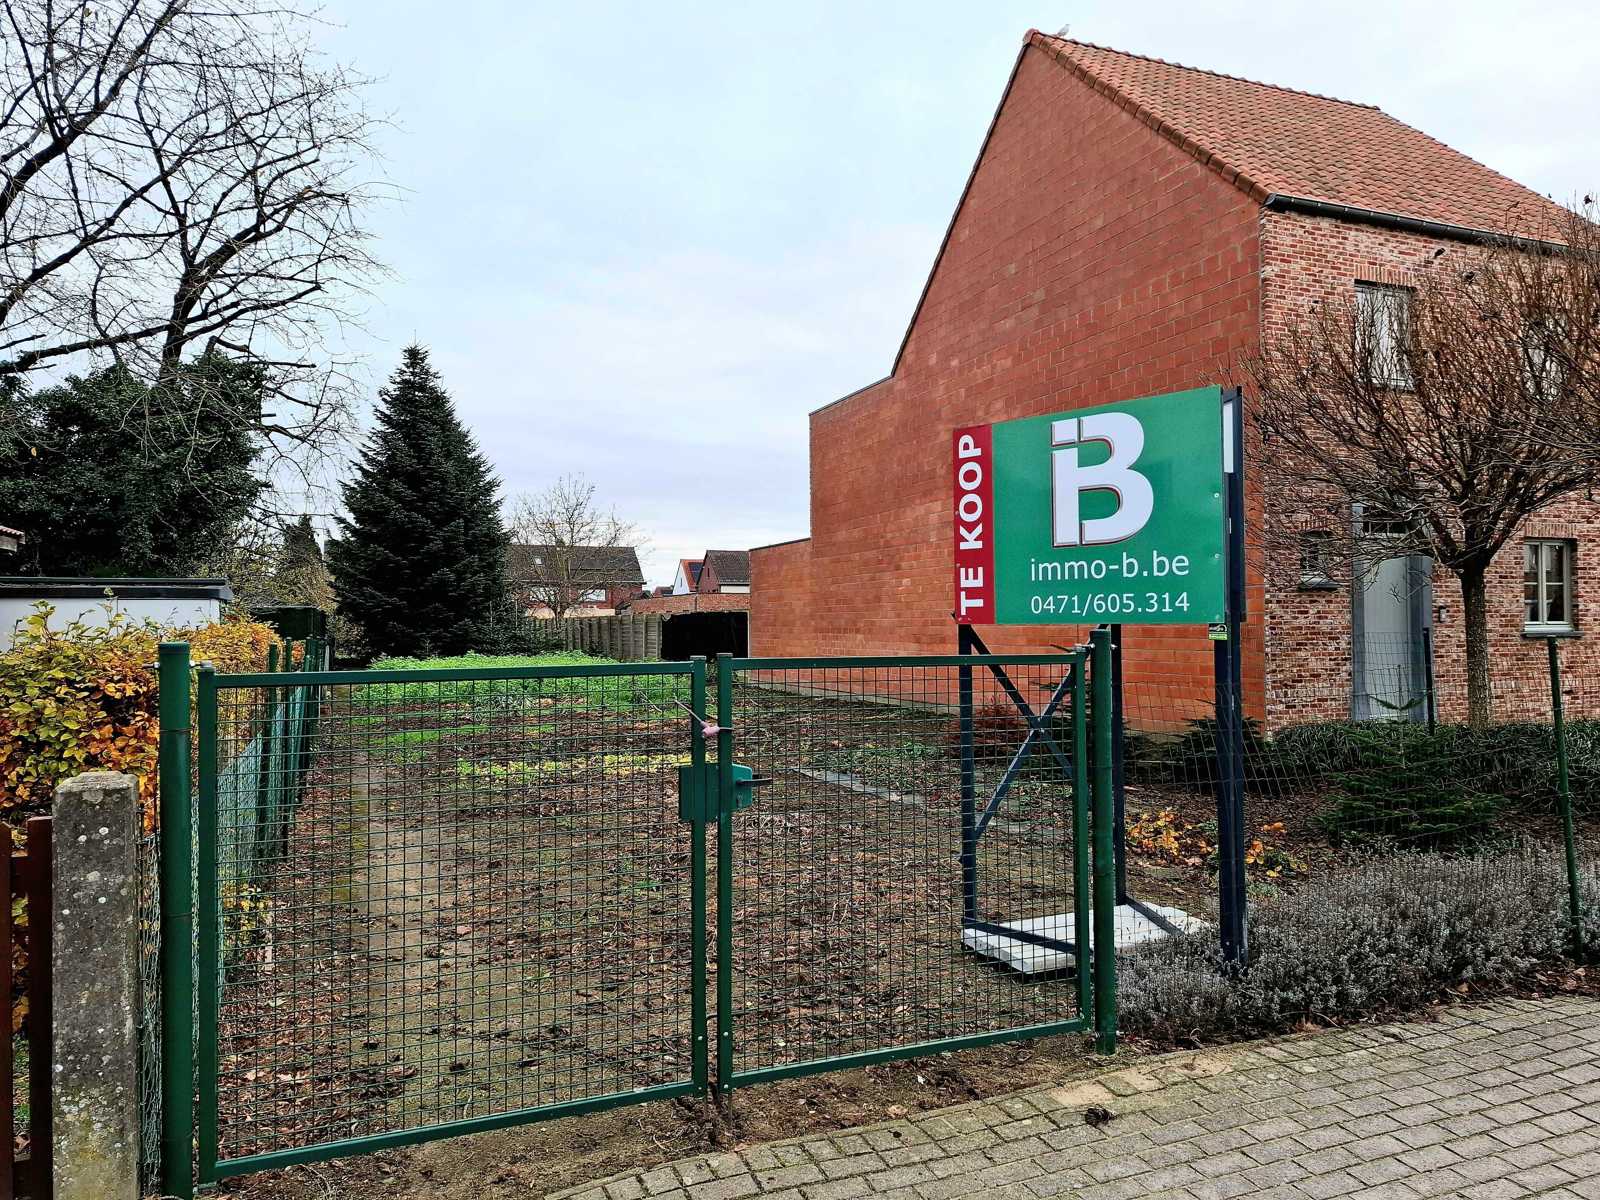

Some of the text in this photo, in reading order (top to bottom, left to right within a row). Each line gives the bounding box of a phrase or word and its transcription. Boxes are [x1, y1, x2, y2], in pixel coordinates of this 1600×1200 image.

[958, 433, 985, 616] TE KOOP
[1030, 550, 1190, 582] immo-b.be
[1030, 591, 1190, 617] 0471/605.314
